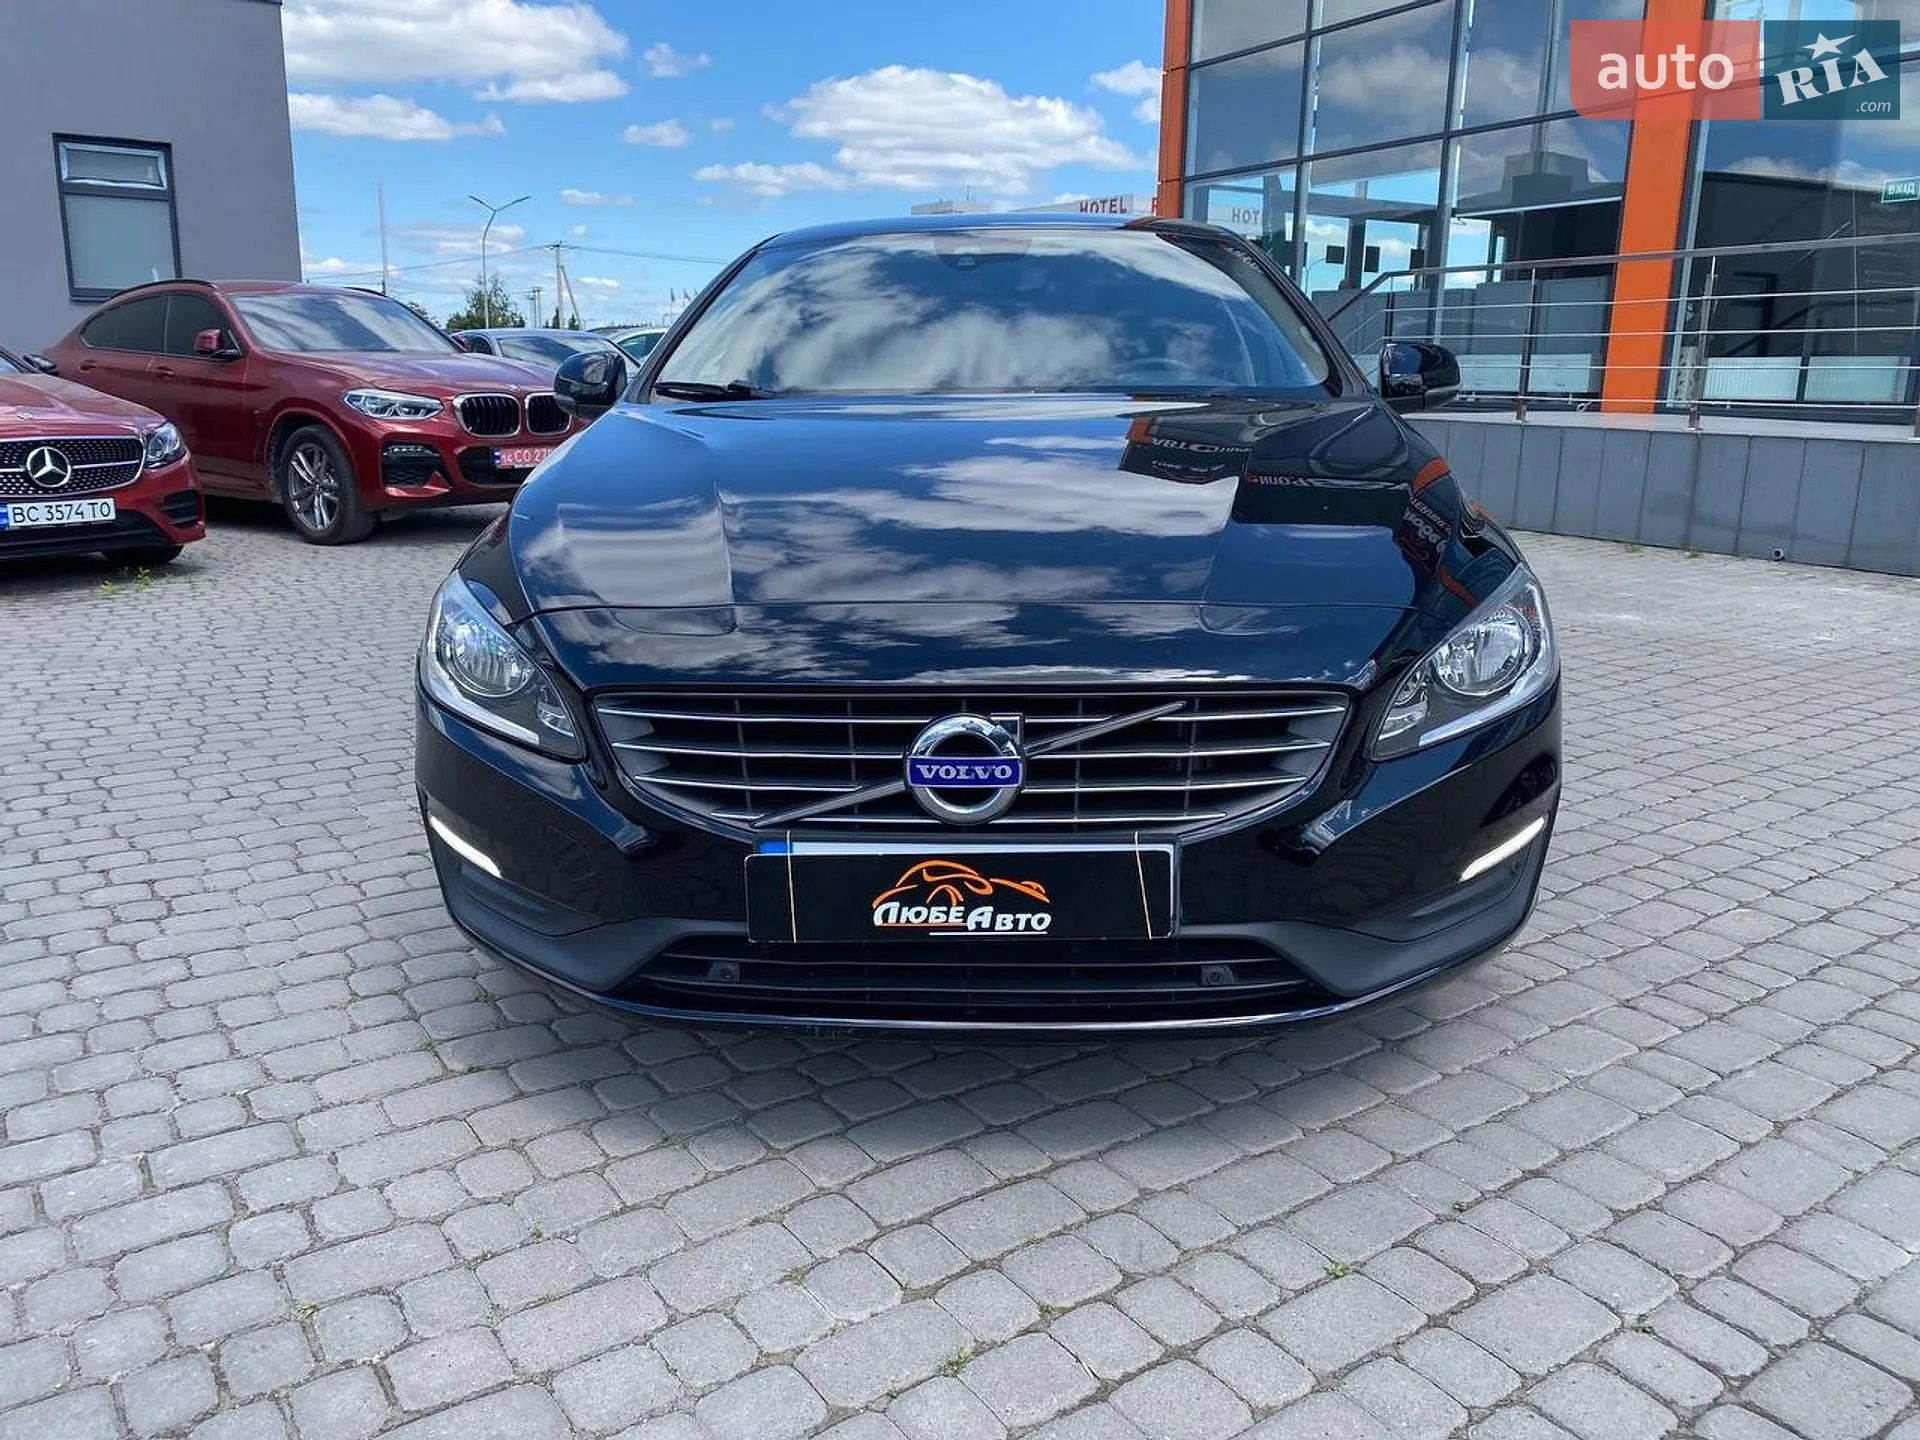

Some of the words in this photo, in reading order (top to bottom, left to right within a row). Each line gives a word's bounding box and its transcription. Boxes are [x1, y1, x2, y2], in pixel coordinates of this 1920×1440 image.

[1080, 196, 1127, 214] HOTEL
[1231, 207, 1260, 224] HOT
[12, 506, 39, 523] BC
[44, 503, 85, 521] 3574
[88, 501, 111, 518] TO
[916, 765, 1012, 780] VOLVO
